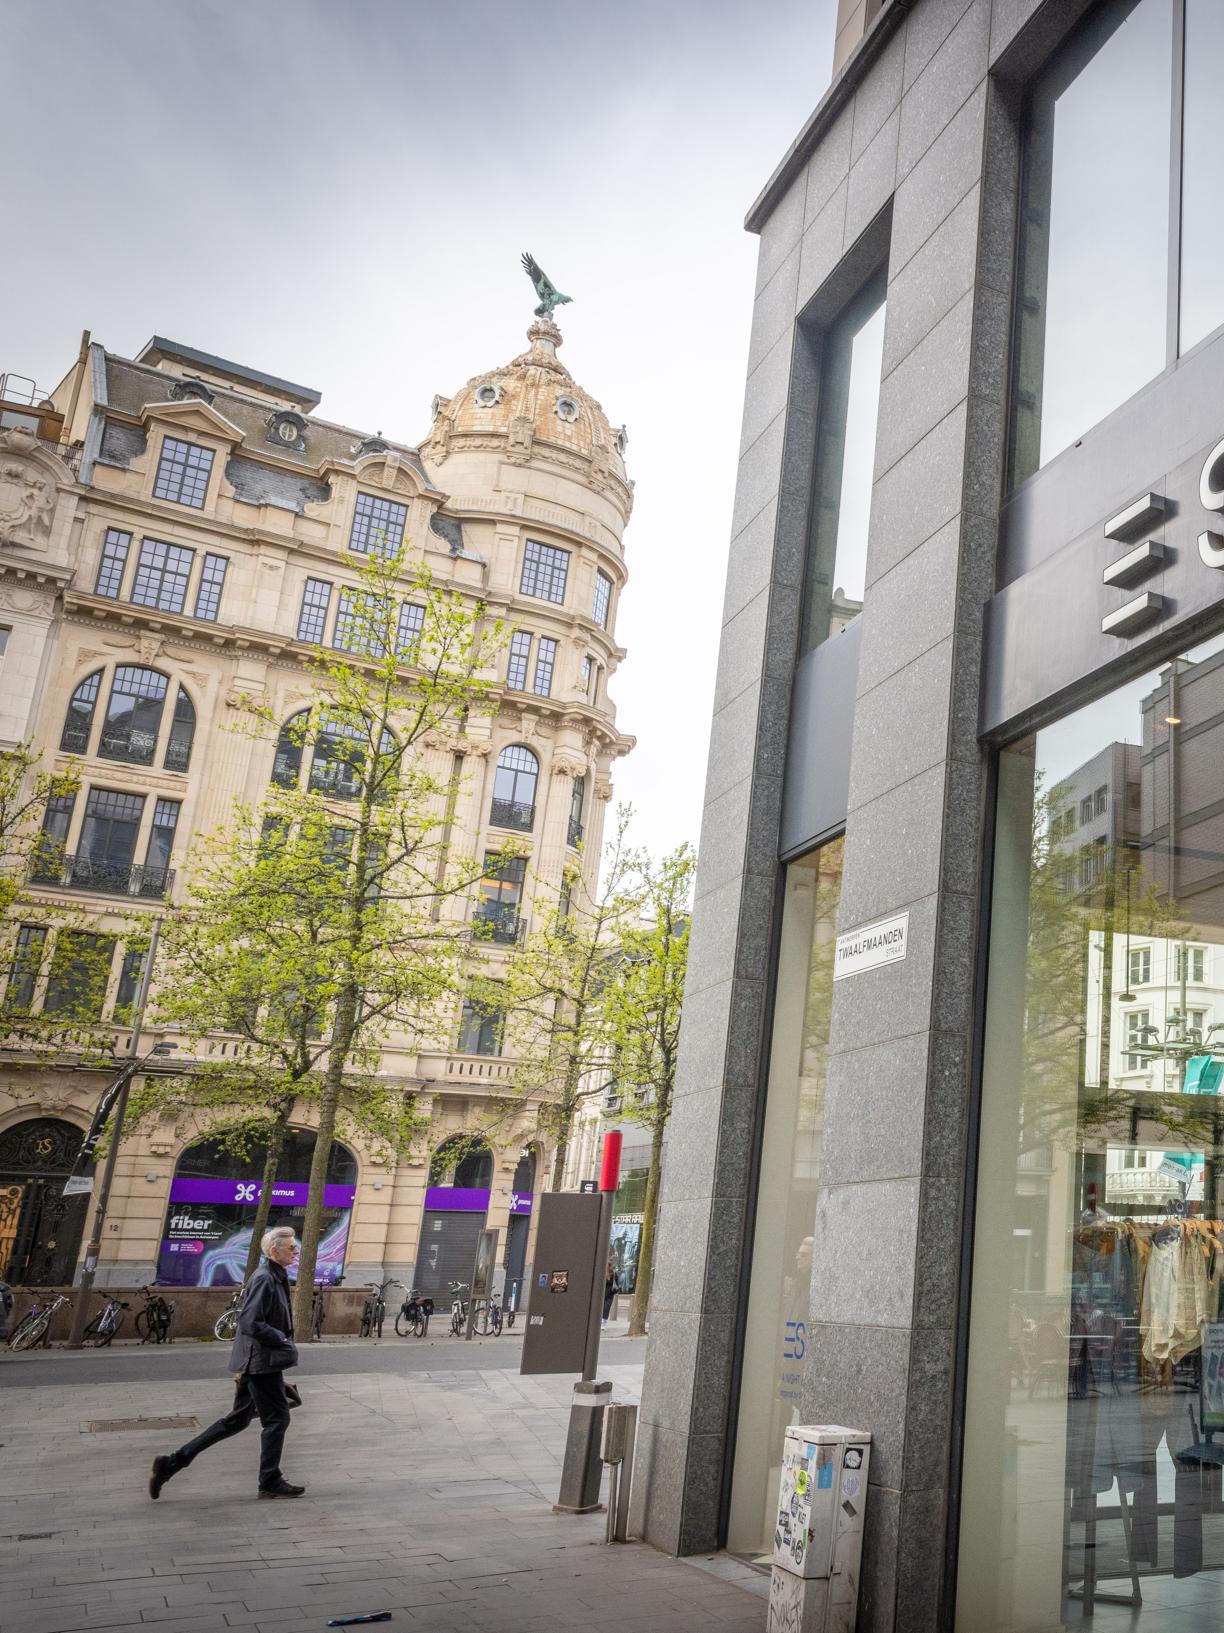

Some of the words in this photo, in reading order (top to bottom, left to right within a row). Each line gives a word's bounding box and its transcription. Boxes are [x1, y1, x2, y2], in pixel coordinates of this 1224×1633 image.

[838, 927, 904, 961] TWAALFMAANDEN
[885, 944, 904, 958] STRAAT
[257, 1189, 295, 1197] pximus
[170, 1216, 212, 1229] fiber
